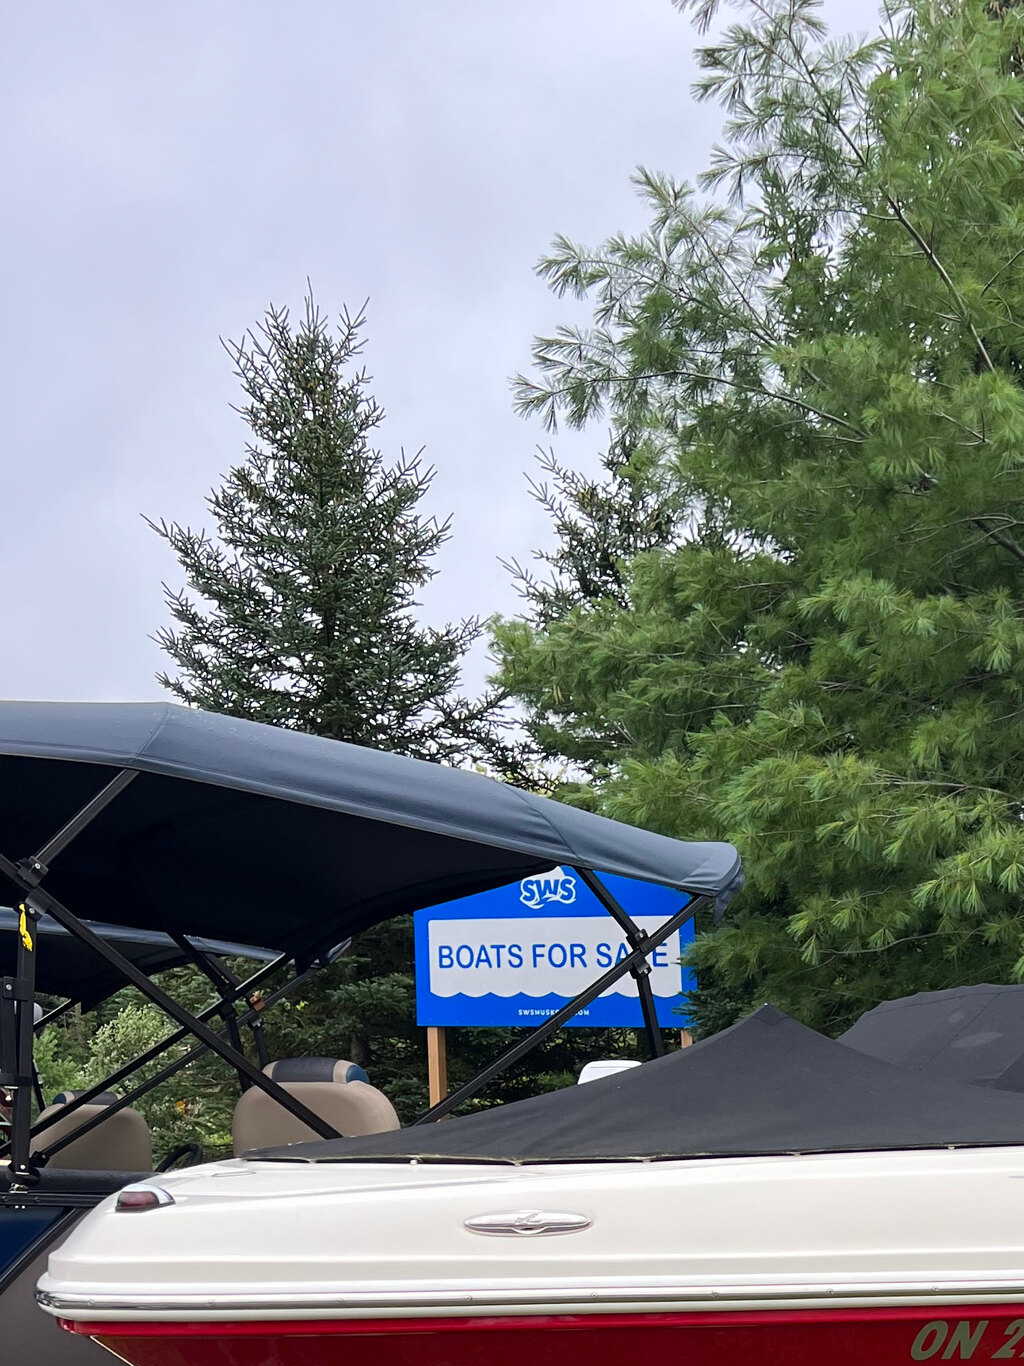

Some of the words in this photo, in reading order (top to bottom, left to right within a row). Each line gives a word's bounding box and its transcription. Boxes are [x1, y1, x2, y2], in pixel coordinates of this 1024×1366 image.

[522, 879, 576, 902] SWS
[438, 944, 523, 969] BOATS
[532, 943, 587, 968] FOR
[596, 942, 669, 968] SAE
[910, 1320, 989, 1361] ON
